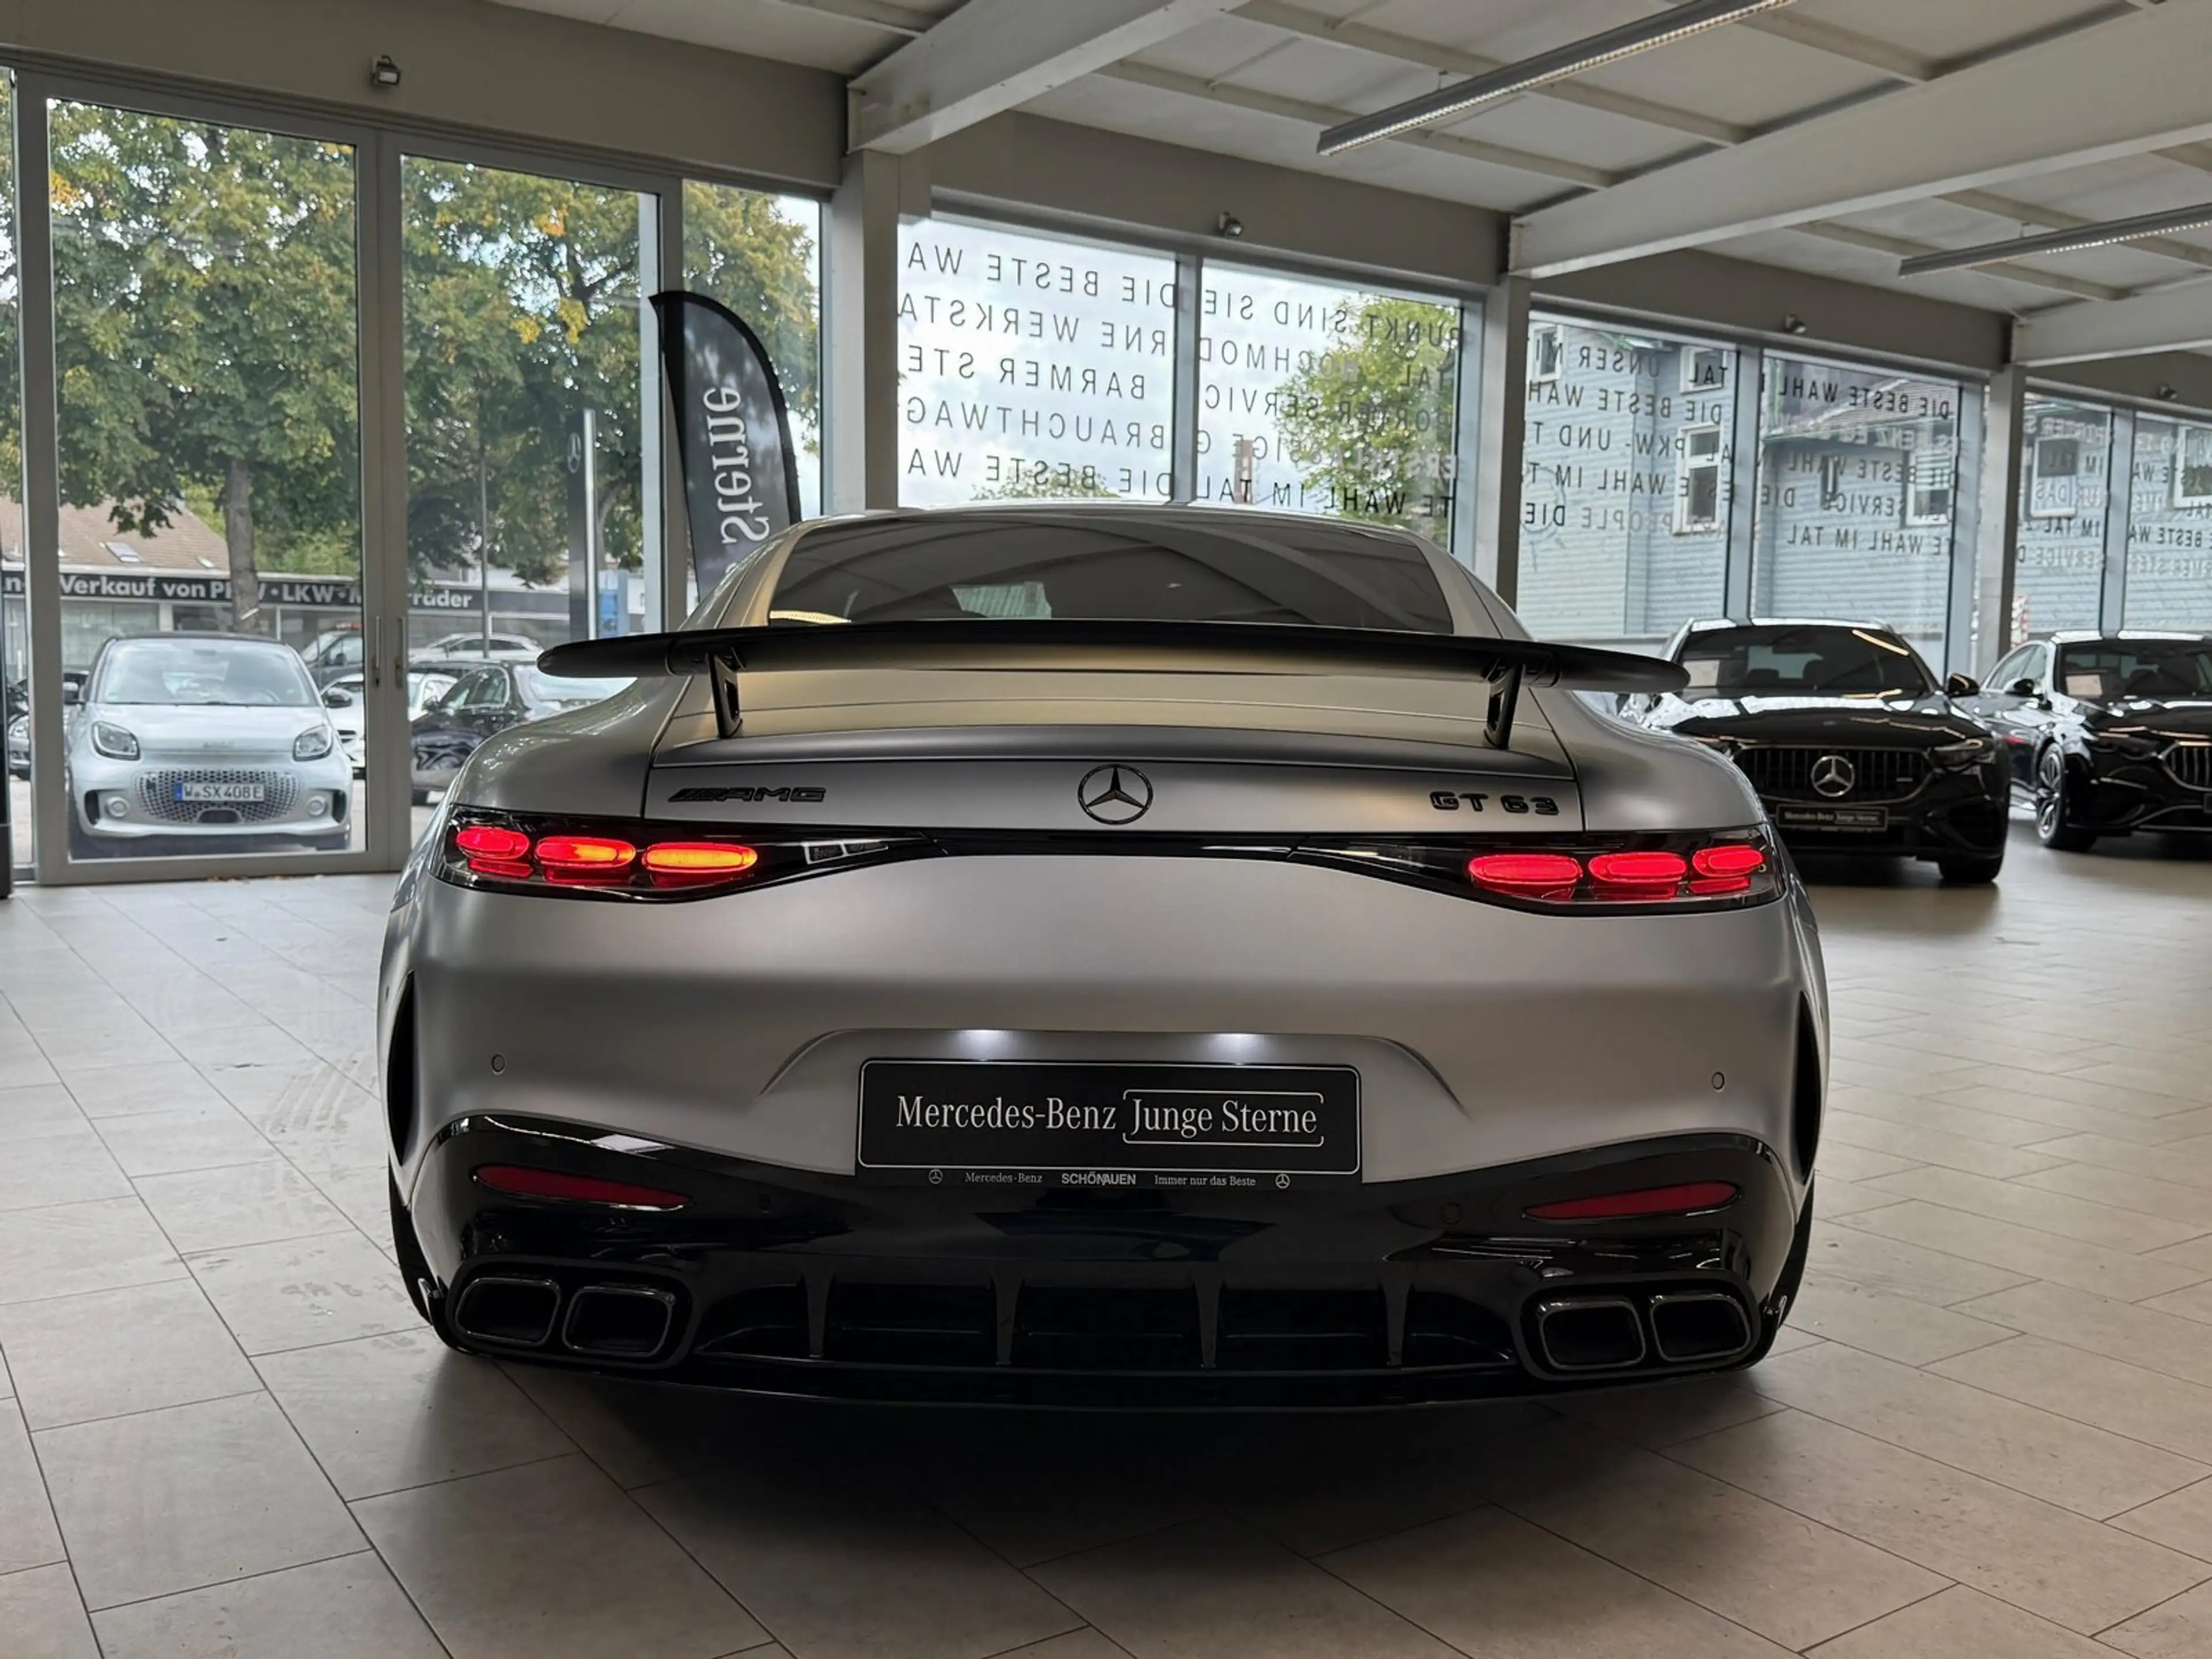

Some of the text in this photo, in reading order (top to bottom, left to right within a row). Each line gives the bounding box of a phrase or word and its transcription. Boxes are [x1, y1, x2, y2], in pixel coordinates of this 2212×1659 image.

[59, 574, 156, 597] Verkauf
[162, 582, 206, 599] von
[282, 583, 334, 604] LKW
[407, 589, 473, 608] räder
[714, 787, 826, 802] AMG
[1429, 791, 1559, 816] GT 63
[896, 1094, 1317, 1139] Mercedes-Benz Junge Sterne
[965, 1171, 1256, 1188] Mercedes-Benz SCHÖNAUEN Immer nur das Beste
